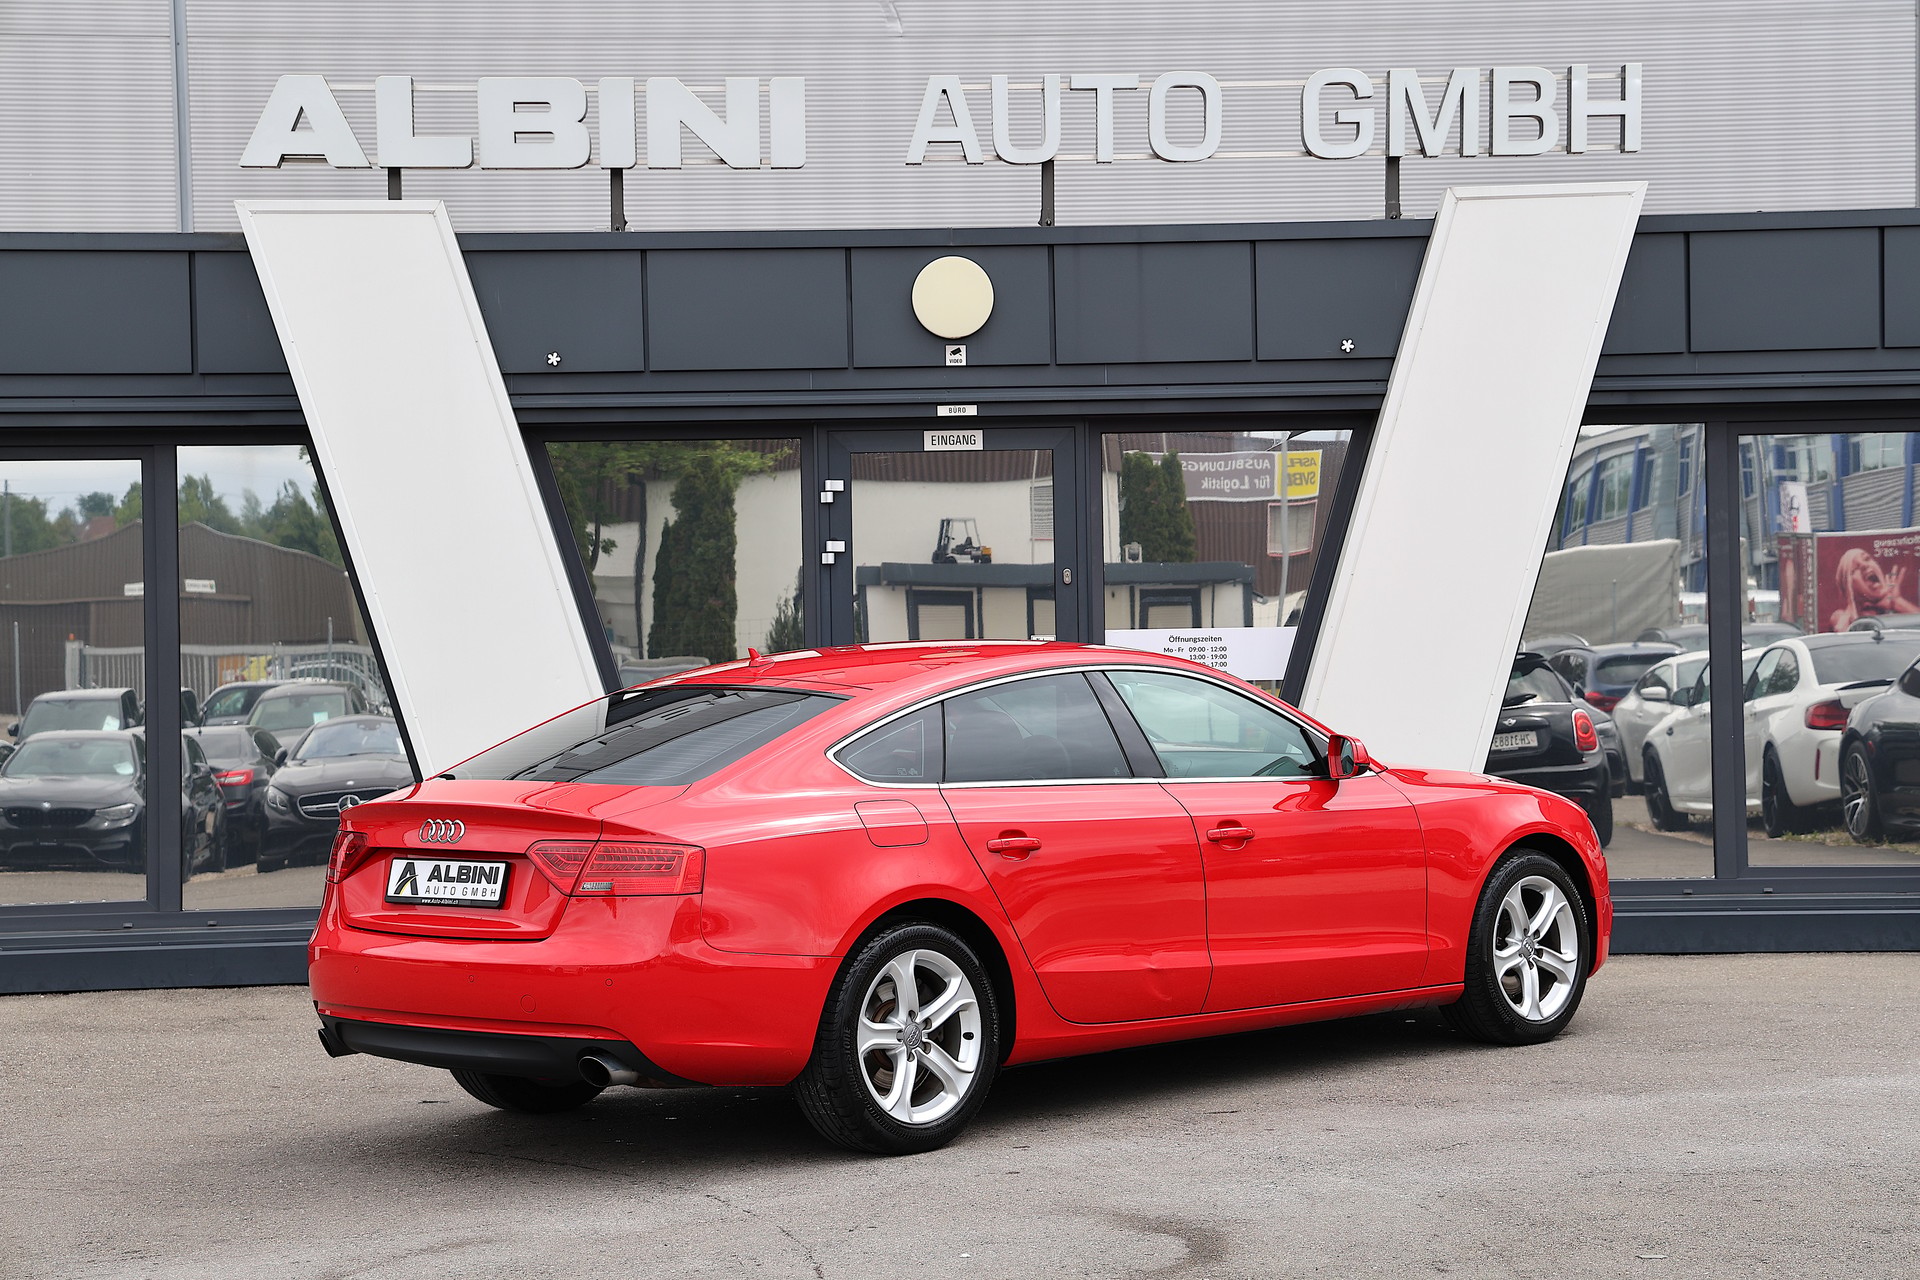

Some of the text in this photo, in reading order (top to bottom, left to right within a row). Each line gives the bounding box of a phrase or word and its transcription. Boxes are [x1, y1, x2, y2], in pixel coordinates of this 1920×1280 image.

[238, 62, 1643, 170] ALBINI AUTO GMBH
[948, 406, 967, 414] BÜRO
[931, 434, 977, 446] EINGANG
[1168, 635, 1222, 643] Öffnungszeiten
[427, 864, 500, 885] ALBINI
[424, 885, 497, 898] AUTO GMBH
